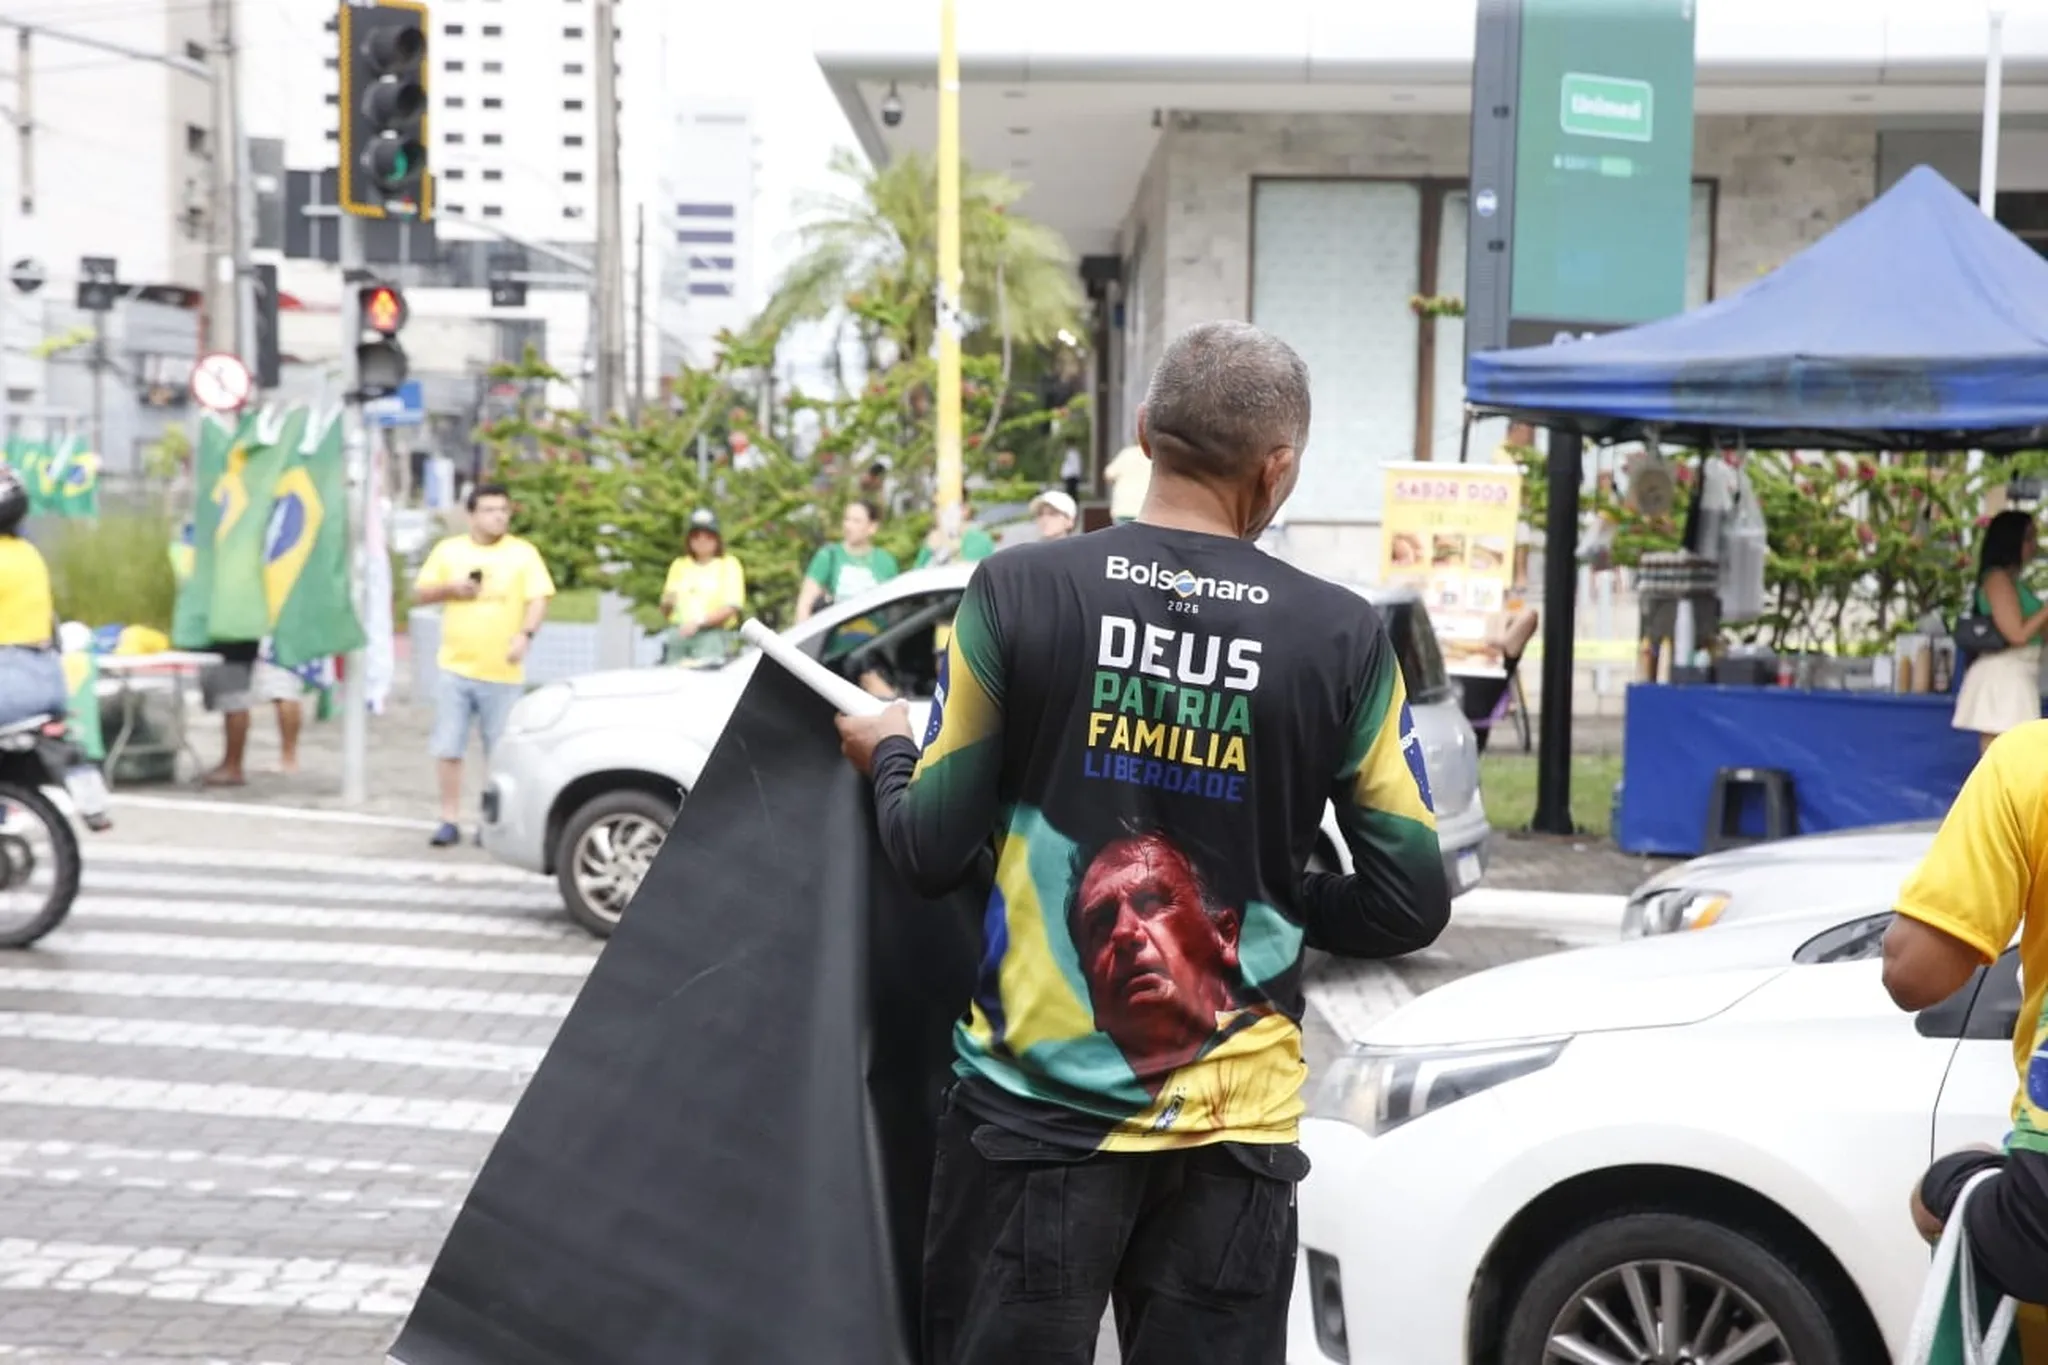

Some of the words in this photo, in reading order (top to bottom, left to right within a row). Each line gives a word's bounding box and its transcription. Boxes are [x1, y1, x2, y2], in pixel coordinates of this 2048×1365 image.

[1105, 555, 1270, 604] Bolsonaro
[1167, 600, 1199, 614] 2026
[1098, 615, 1262, 690] DEUS
[1092, 670, 1252, 736] PATRIA
[1087, 711, 1247, 772] FAMILIA
[1083, 750, 1247, 802] LIBERDADE
